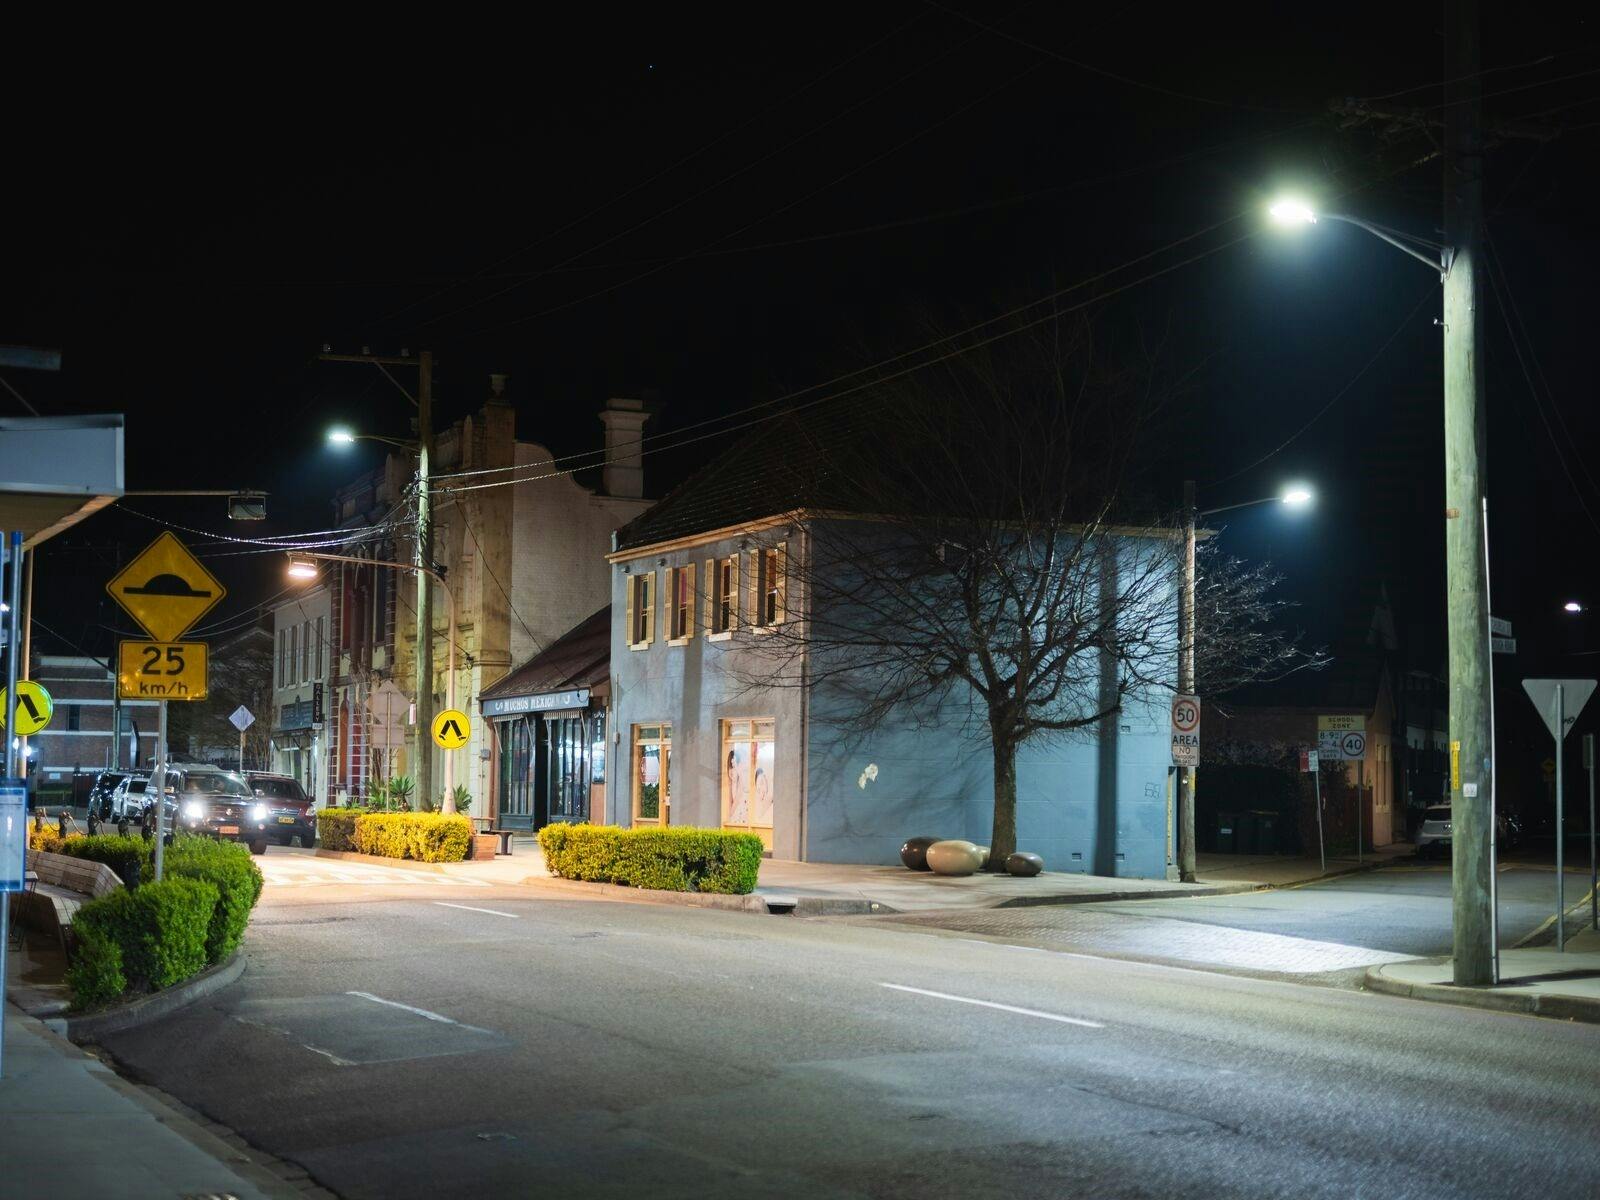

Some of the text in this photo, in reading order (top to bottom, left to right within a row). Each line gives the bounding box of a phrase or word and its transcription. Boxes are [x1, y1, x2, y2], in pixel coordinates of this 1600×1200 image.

[142, 646, 185, 676] 25
[139, 681, 188, 695] km/h
[1177, 708, 1195, 723] 50
[1172, 735, 1199, 745] AREA
[1345, 739, 1362, 750] 40
[1179, 746, 1191, 755] NO
